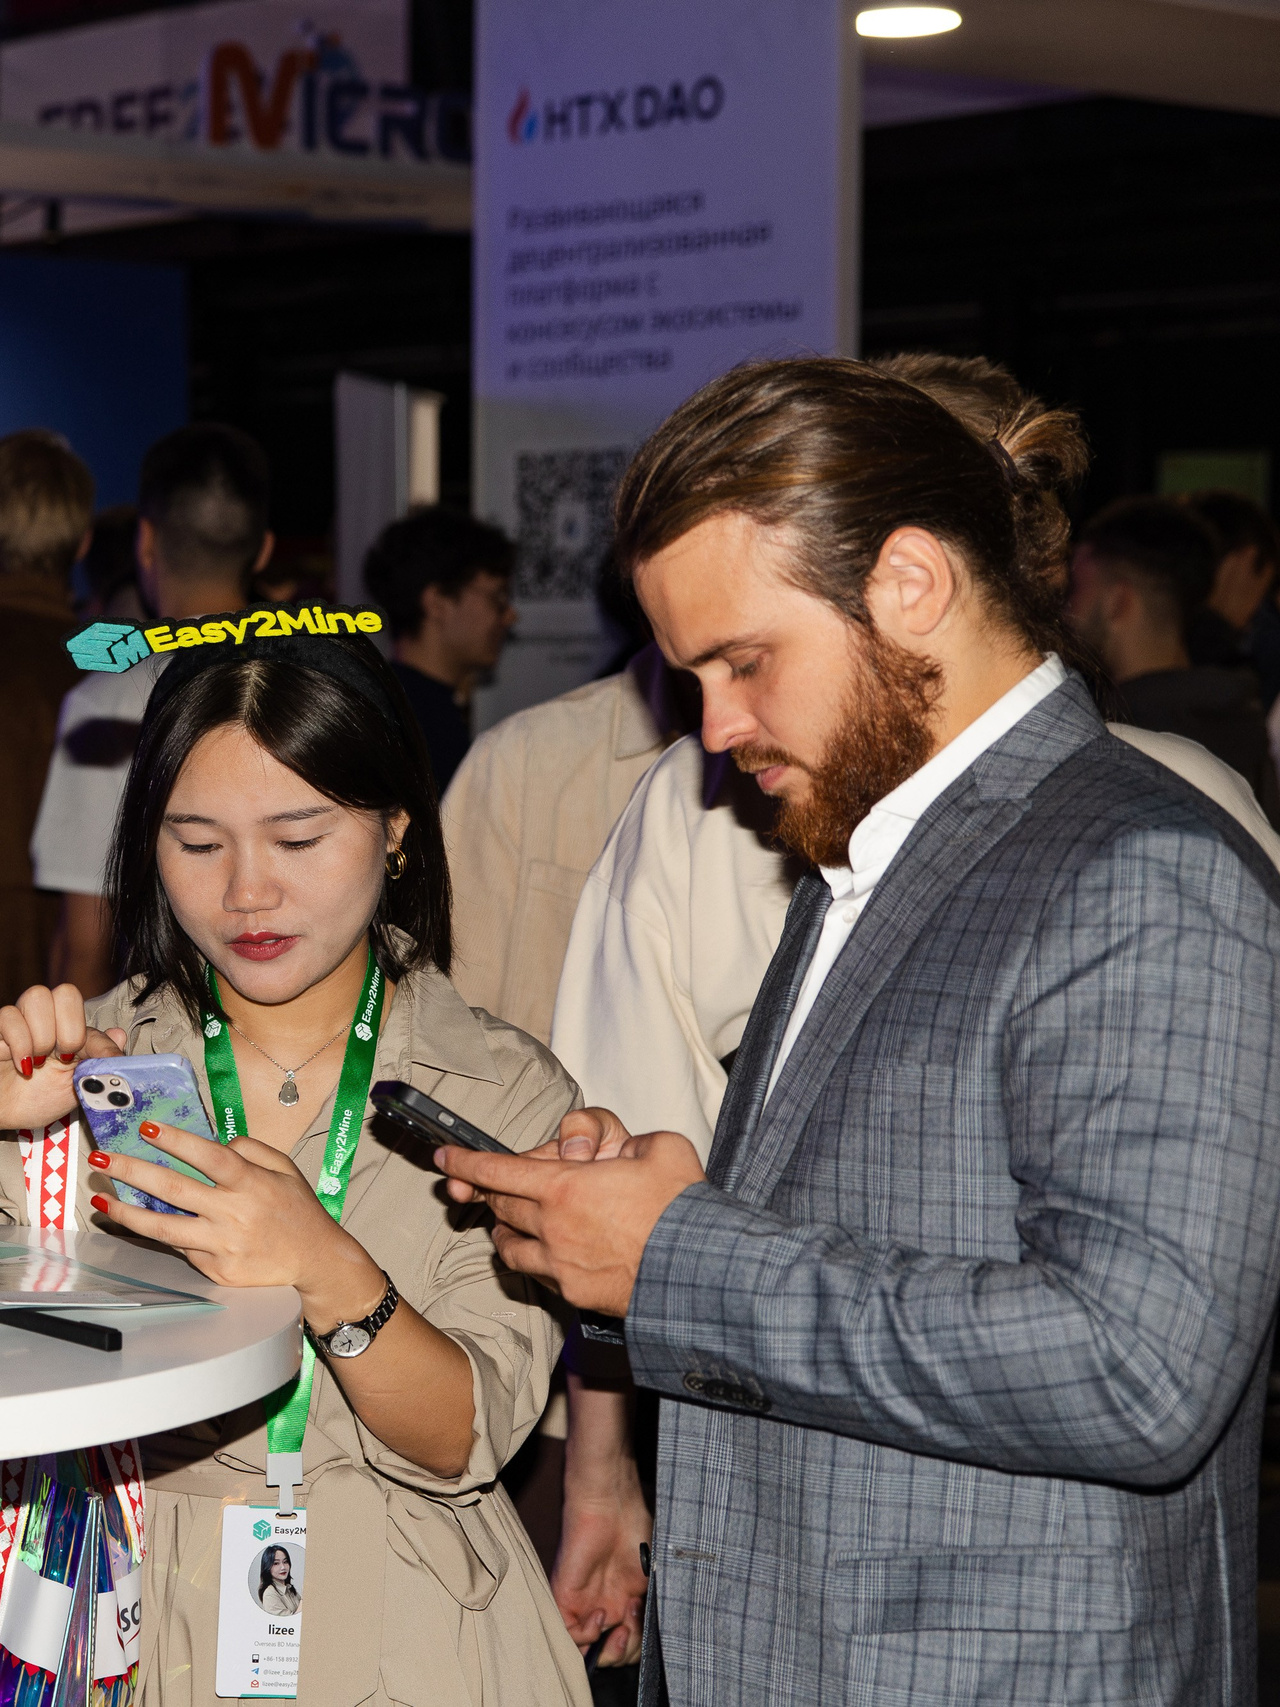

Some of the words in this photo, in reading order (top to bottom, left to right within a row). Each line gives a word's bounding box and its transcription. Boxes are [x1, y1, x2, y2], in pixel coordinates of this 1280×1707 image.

[543, 90, 625, 140] HTX
[634, 75, 724, 130] DAO
[144, 606, 384, 653] Easy2Mine
[361, 966, 380, 1023] Easy2Mine
[329, 1109, 353, 1176] Easy2Mine
[253, 1640, 277, 1648] Overseas
[268, 1624, 295, 1636] lizee
